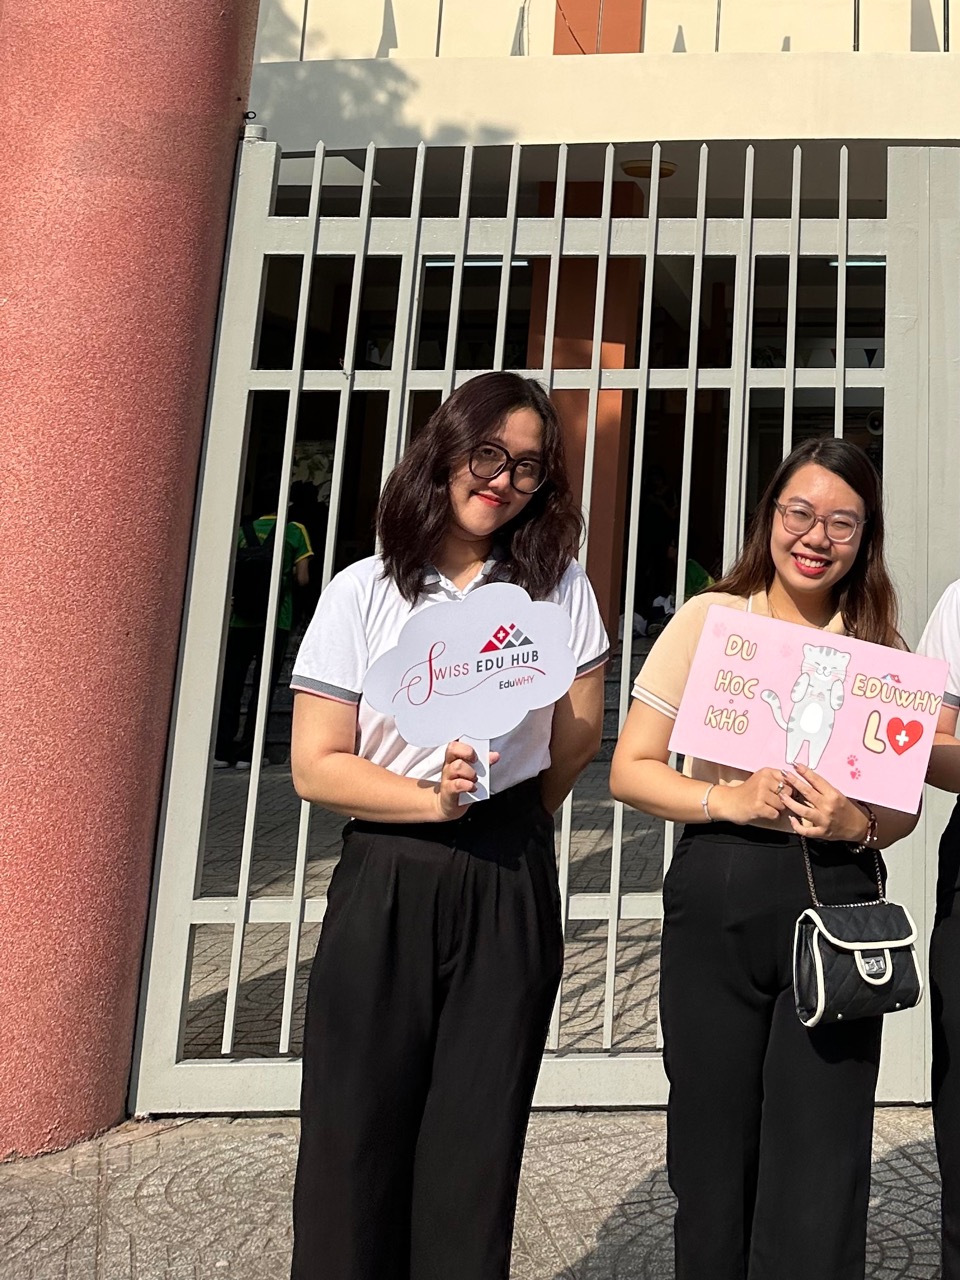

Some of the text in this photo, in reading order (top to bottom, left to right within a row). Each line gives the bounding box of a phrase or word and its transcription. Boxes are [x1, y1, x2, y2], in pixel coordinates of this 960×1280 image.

[724, 634, 758, 661] DU
[476, 656, 504, 674] EDU
[511, 650, 540, 667] HUB
[498, 675, 535, 690] EduWHY
[714, 669, 760, 705] HỌC
[851, 672, 943, 715] EDUWHY
[704, 705, 750, 735] KHÓ
